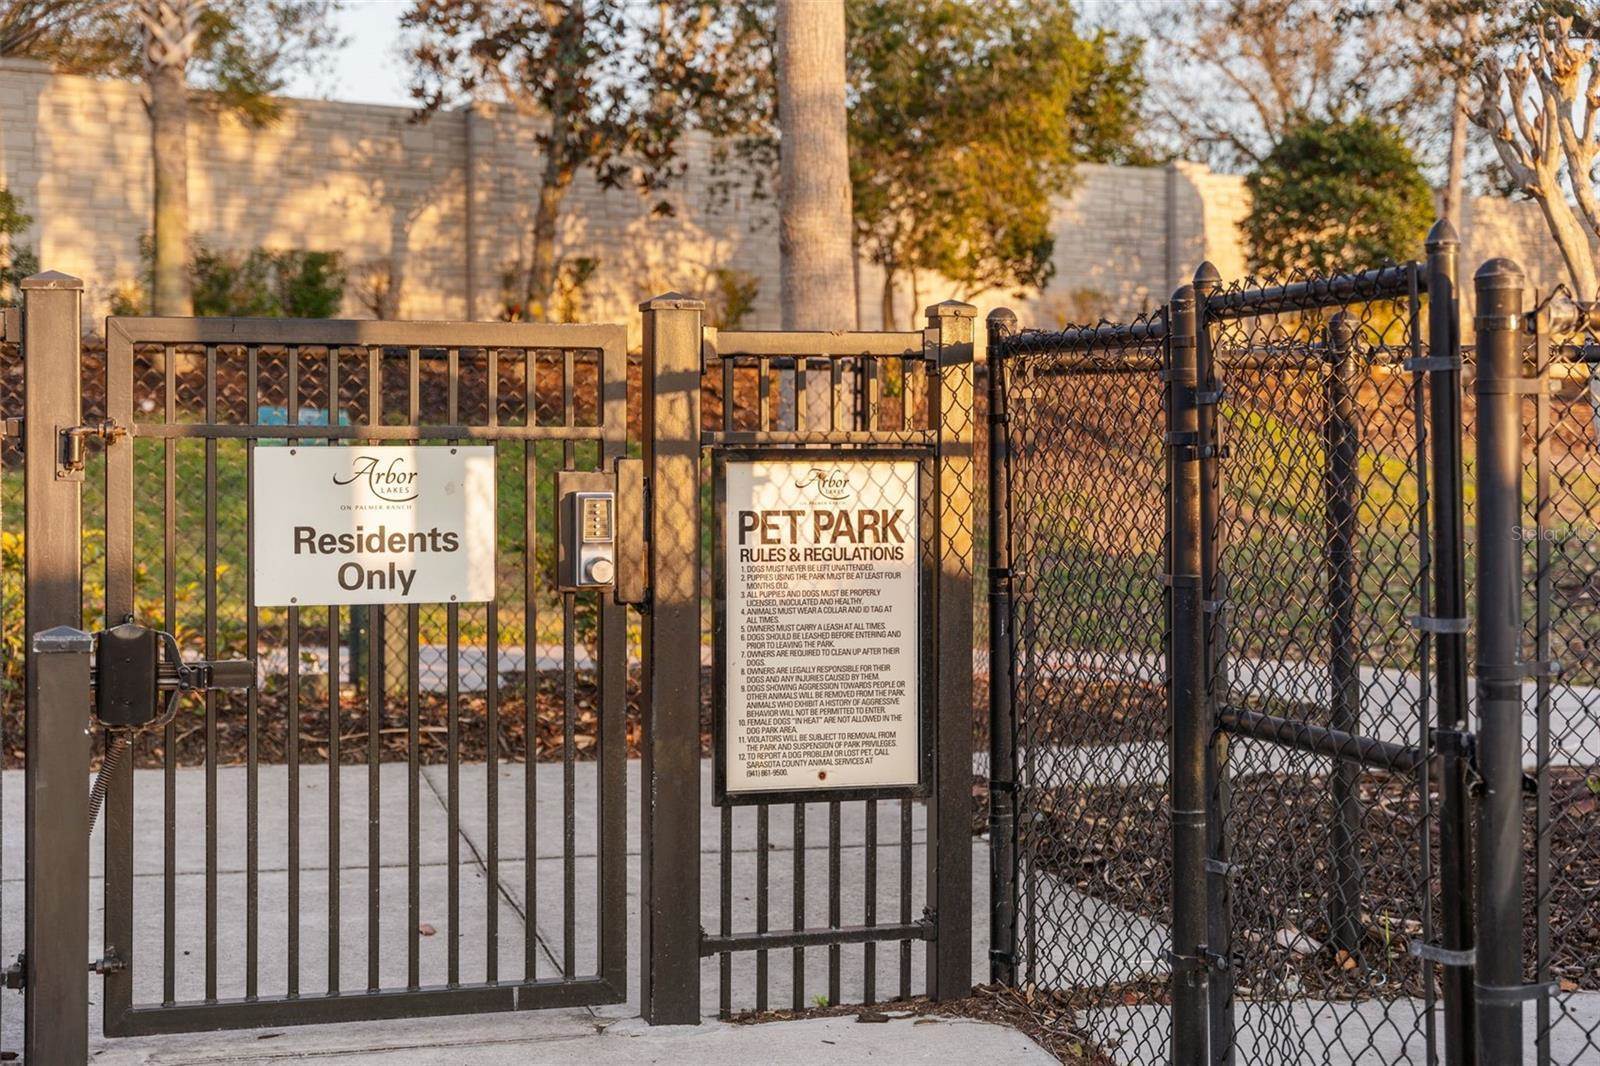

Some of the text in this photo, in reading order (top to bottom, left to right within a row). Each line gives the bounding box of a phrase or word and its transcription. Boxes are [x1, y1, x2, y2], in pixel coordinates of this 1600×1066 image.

[332, 456, 419, 502] Arbor
[738, 509, 905, 545] PET PARK
[294, 526, 459, 554] Residents
[740, 546, 904, 563] RULES & REGULATIONS
[746, 565, 765, 573] DOGS
[766, 564, 784, 572] MUST
[785, 564, 806, 572] NEVER
[807, 564, 815, 572] BE
[816, 564, 830, 572] LEFT
[338, 562, 416, 596] Only
[747, 573, 773, 581] PUPPIES
[774, 573, 795, 581] USING
[808, 572, 826, 580] PARK
[826, 572, 845, 580] MUST
[846, 572, 855, 580] BE
[884, 571, 901, 579] FOUR
[746, 582, 775, 590] MONTHS
[747, 590, 757, 598] ALL
[759, 590, 785, 598] PUPPIES
[802, 589, 820, 597] DOGS
[821, 589, 839, 597] MUST
[840, 589, 849, 597] BE
[747, 607, 777, 615] ANIMALS
[777, 607, 796, 615] MUST
[797, 606, 817, 614] WEAR
[823, 606, 847, 614] COLLAR
[848, 605, 862, 613] AND
[863, 605, 870, 613] ID
[871, 605, 883, 613] TAG
[884, 605, 892, 613] AT
[746, 616, 757, 624] ALL
[747, 624, 776, 632] OWNERS
[776, 624, 795, 632] MUST
[796, 623, 816, 631] CARRY
[823, 623, 844, 631] LEASH
[844, 622, 853, 630] AT
[854, 622, 864, 630] ALL
[747, 633, 765, 641] DOGS
[766, 632, 792, 640] SHOULD
[792, 632, 801, 640] BE
[802, 631, 830, 640] LEASHED
[831, 631, 854, 639] BEFORE
[887, 630, 901, 638] AND
[746, 640, 816, 649] PRIOR TO LEAVING THE
[747, 649, 775, 658] OWNERS
[776, 649, 788, 657] ARE
[822, 648, 830, 656] TO
[830, 648, 851, 656] CLEAN
[852, 647, 861, 655] UP
[862, 647, 881, 655] AFTER
[883, 647, 900, 655] THEIR
[747, 666, 775, 675] OWNERS
[776, 666, 788, 674] ARE
[789, 665, 816, 674] LEGALLY
[860, 664, 872, 672] FOR
[873, 664, 890, 672] THEIR
[746, 675, 765, 683] DOGS
[765, 675, 780, 683] AND
[781, 674, 794, 682] ANY
[824, 673, 850, 681] CAUSED
[851, 673, 859, 681] BY
[747, 684, 765, 692] DOGS
[766, 683, 797, 691] SHOWING
[840, 681, 872, 689] TOWARDS
[872, 680, 896, 688] PEOPLE
[896, 680, 905, 688] OR
[746, 692, 767, 700] OTHER
[768, 691, 798, 700] ANIMALS
[798, 691, 813, 699] WILL
[824, 690, 855, 698] REMOVED
[856, 689, 874, 697] FROM
[875, 689, 887, 697] THE
[747, 700, 776, 709] ANIMALS
[777, 700, 794, 708] WHO
[794, 699, 818, 707] EXHIBIT
[824, 698, 852, 707] HISTORY
[852, 698, 861, 706] OF
[779, 708, 794, 716] WILL
[795, 708, 809, 716] NOT
[856, 706, 864, 714] TO
[747, 713, 902, 726] FEMALE DOGS ARE NOT ALLOWED IN THE
[746, 726, 778, 734] DOG PARK
[782, 734, 797, 742] WILL
[799, 733, 807, 741] BE
[808, 732, 836, 741] SUBJECT
[838, 732, 846, 740] TO
[847, 731, 876, 740] REMOVAL
[878, 730, 896, 739] FROM
[747, 743, 758, 751] THE
[759, 743, 777, 751] PARK
[778, 742, 792, 750] AND
[843, 740, 861, 748] PARK
[748, 752, 756, 760] TO
[757, 751, 781, 759] REPORT
[788, 750, 802, 758] DOG
[802, 749, 833, 758] PROBLEM
[834, 749, 843, 757] OR
[844, 748, 860, 756] LOST
[874, 747, 888, 755] CALL
[781, 759, 807, 767] COUNTY
[808, 758, 833, 766] ANIMAL
[865, 756, 873, 764] AT
